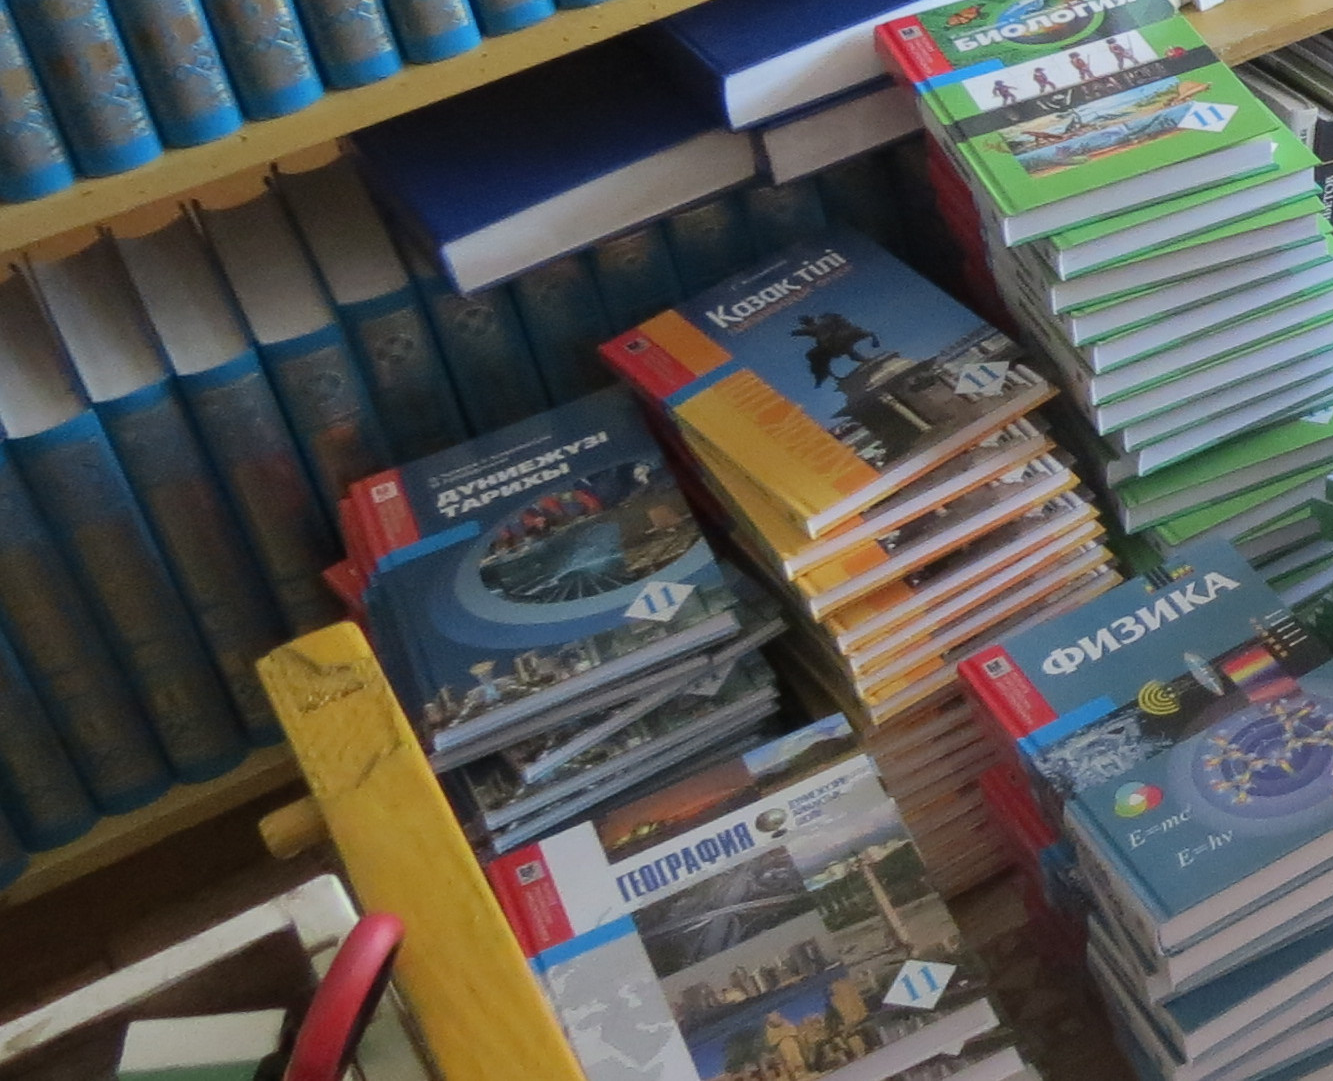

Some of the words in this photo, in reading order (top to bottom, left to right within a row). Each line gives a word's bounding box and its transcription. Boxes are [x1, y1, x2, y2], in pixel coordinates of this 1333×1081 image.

[1193, 103, 1228, 129] 11
[967, 363, 998, 392] 11
[439, 462, 571, 518] ТАРИХЫ
[643, 583, 676, 616] 11
[1040, 571, 1241, 677] ФИЗИКА
[615, 821, 755, 904] ГЕОГРАФИЯ
[901, 965, 942, 1003] 11
